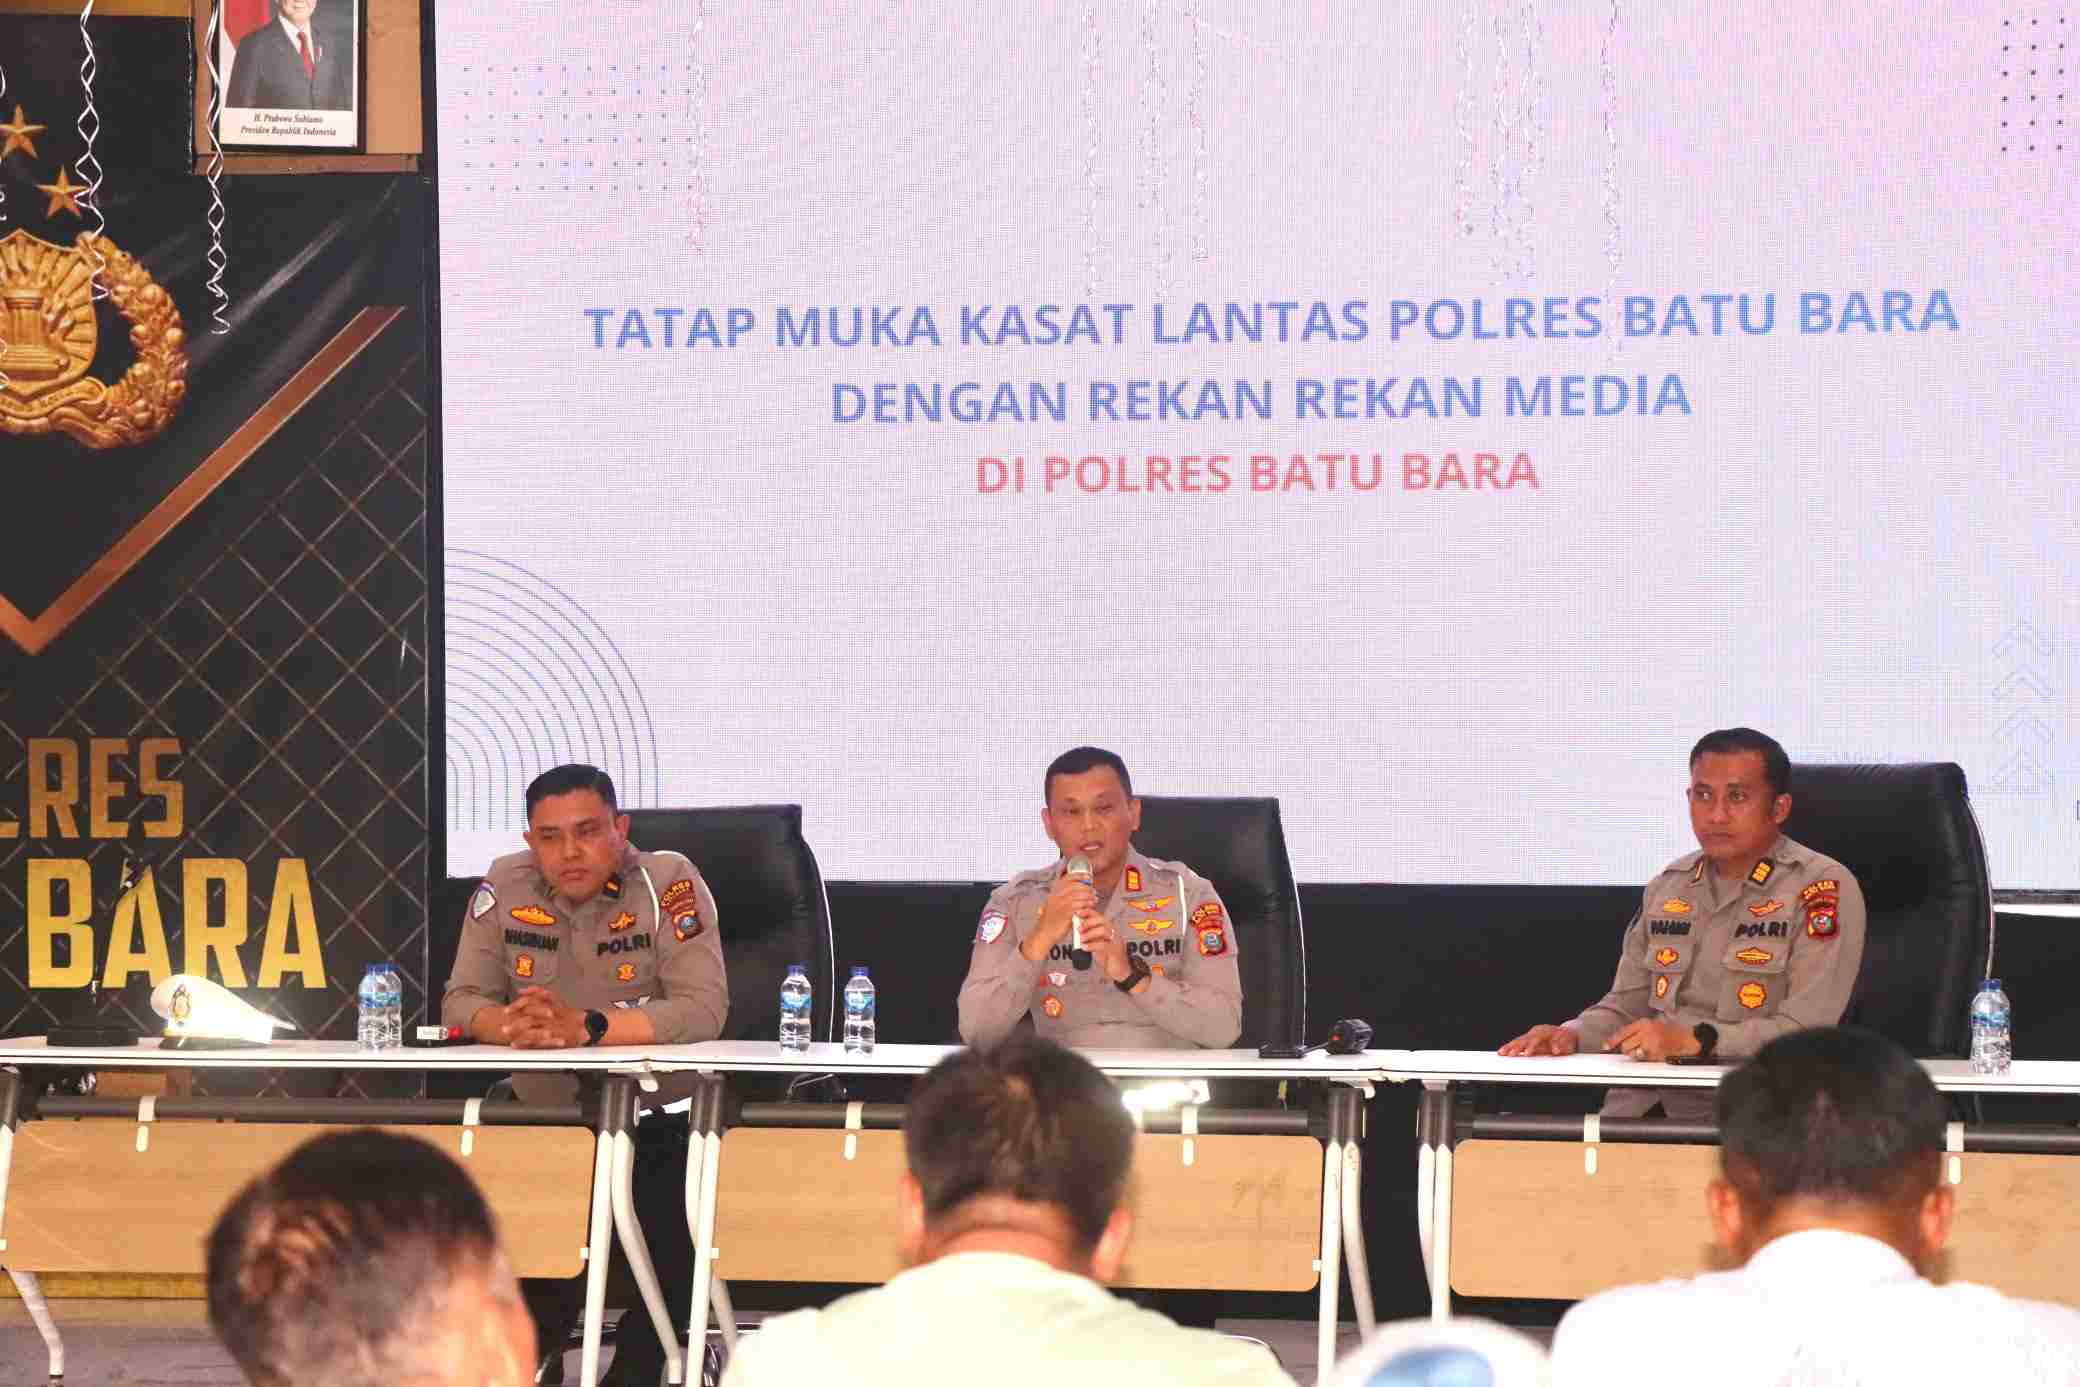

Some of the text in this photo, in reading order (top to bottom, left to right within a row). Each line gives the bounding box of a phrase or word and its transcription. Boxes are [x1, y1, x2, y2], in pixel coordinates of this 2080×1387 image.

[303, 127, 337, 136] Indonesia
[584, 289, 1960, 348] TATAP MUKA KASAT LANTAS POLRES BATU BARA
[832, 374, 1693, 422] DENGAN REKAN REKAN MEDIA
[976, 451, 1540, 494] DI POLRES BATU BARA
[0, 738, 184, 838] RES
[27, 858, 327, 989] BARA
[597, 932, 651, 957] POLRI
[1735, 921, 1788, 937] POLRI
[1126, 938, 1181, 957] POLRI
